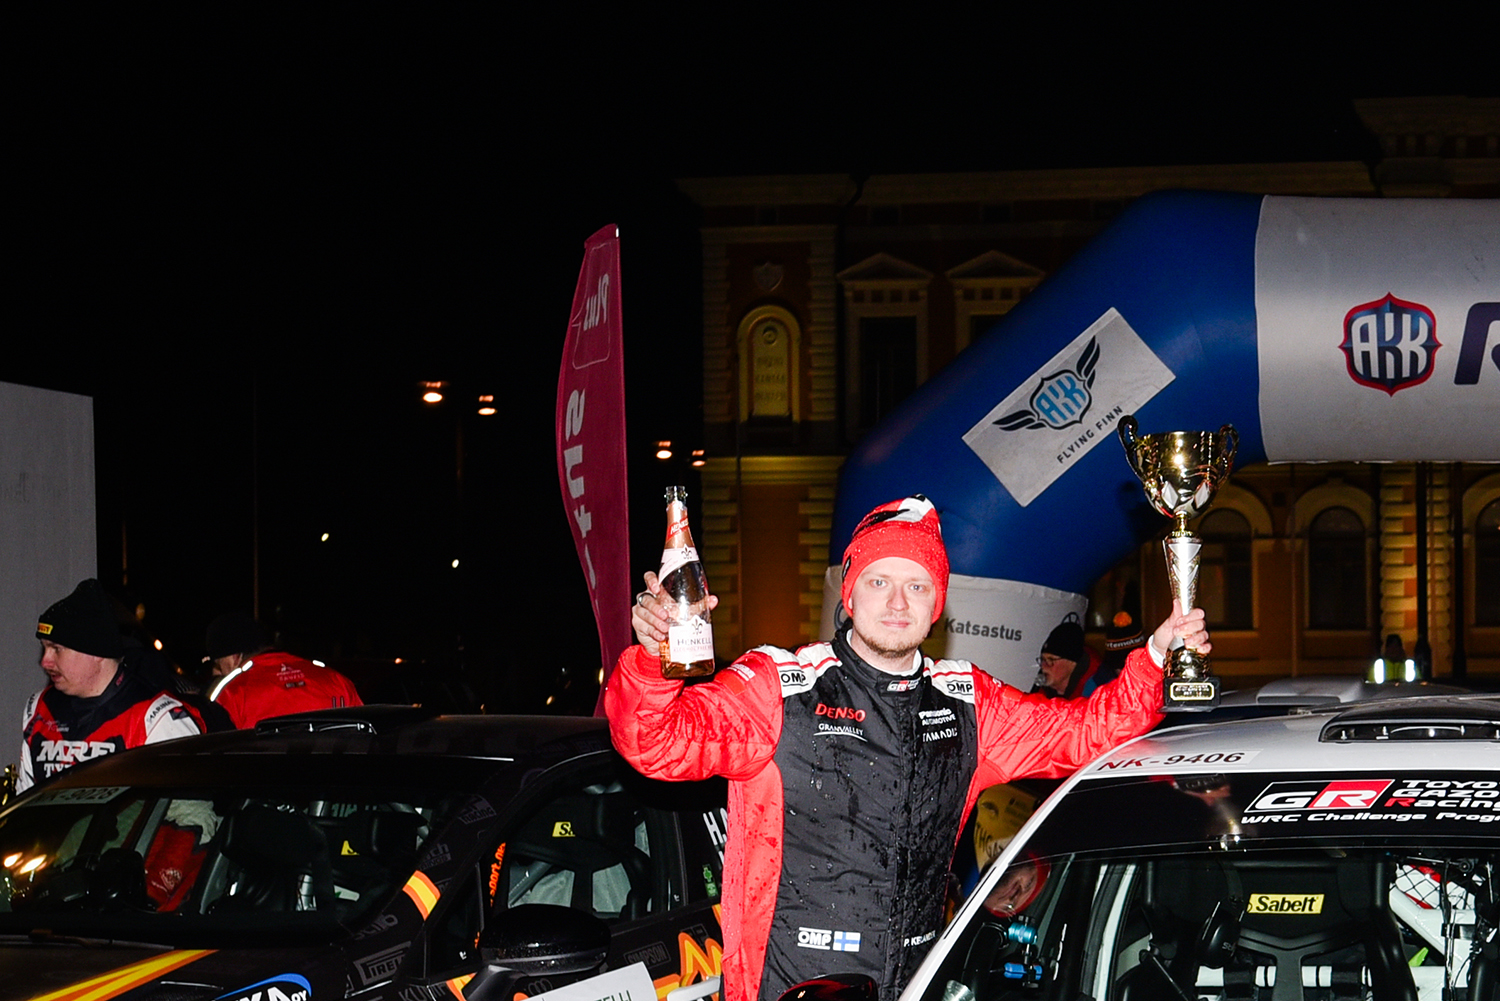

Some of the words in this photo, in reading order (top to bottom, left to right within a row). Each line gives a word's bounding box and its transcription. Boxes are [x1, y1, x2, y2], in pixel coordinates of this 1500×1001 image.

[1351, 311, 1430, 380] AKK
[1035, 373, 1088, 426] AKK
[1057, 430, 1096, 464] FLYING
[1095, 405, 1125, 432] FINN
[946, 618, 1024, 643] Katsastus
[781, 671, 807, 685] OMP
[947, 682, 974, 694] OMP
[815, 703, 867, 722] DENSO
[818, 722, 865, 737] GRANVALLEY
[1096, 751, 1246, 772] NK-9406
[1254, 791, 1378, 809] GR
[1240, 814, 1303, 825] WRC
[1306, 812, 1428, 823] Challenge
[1255, 895, 1317, 912] Sabelt
[797, 930, 832, 947] OMP
